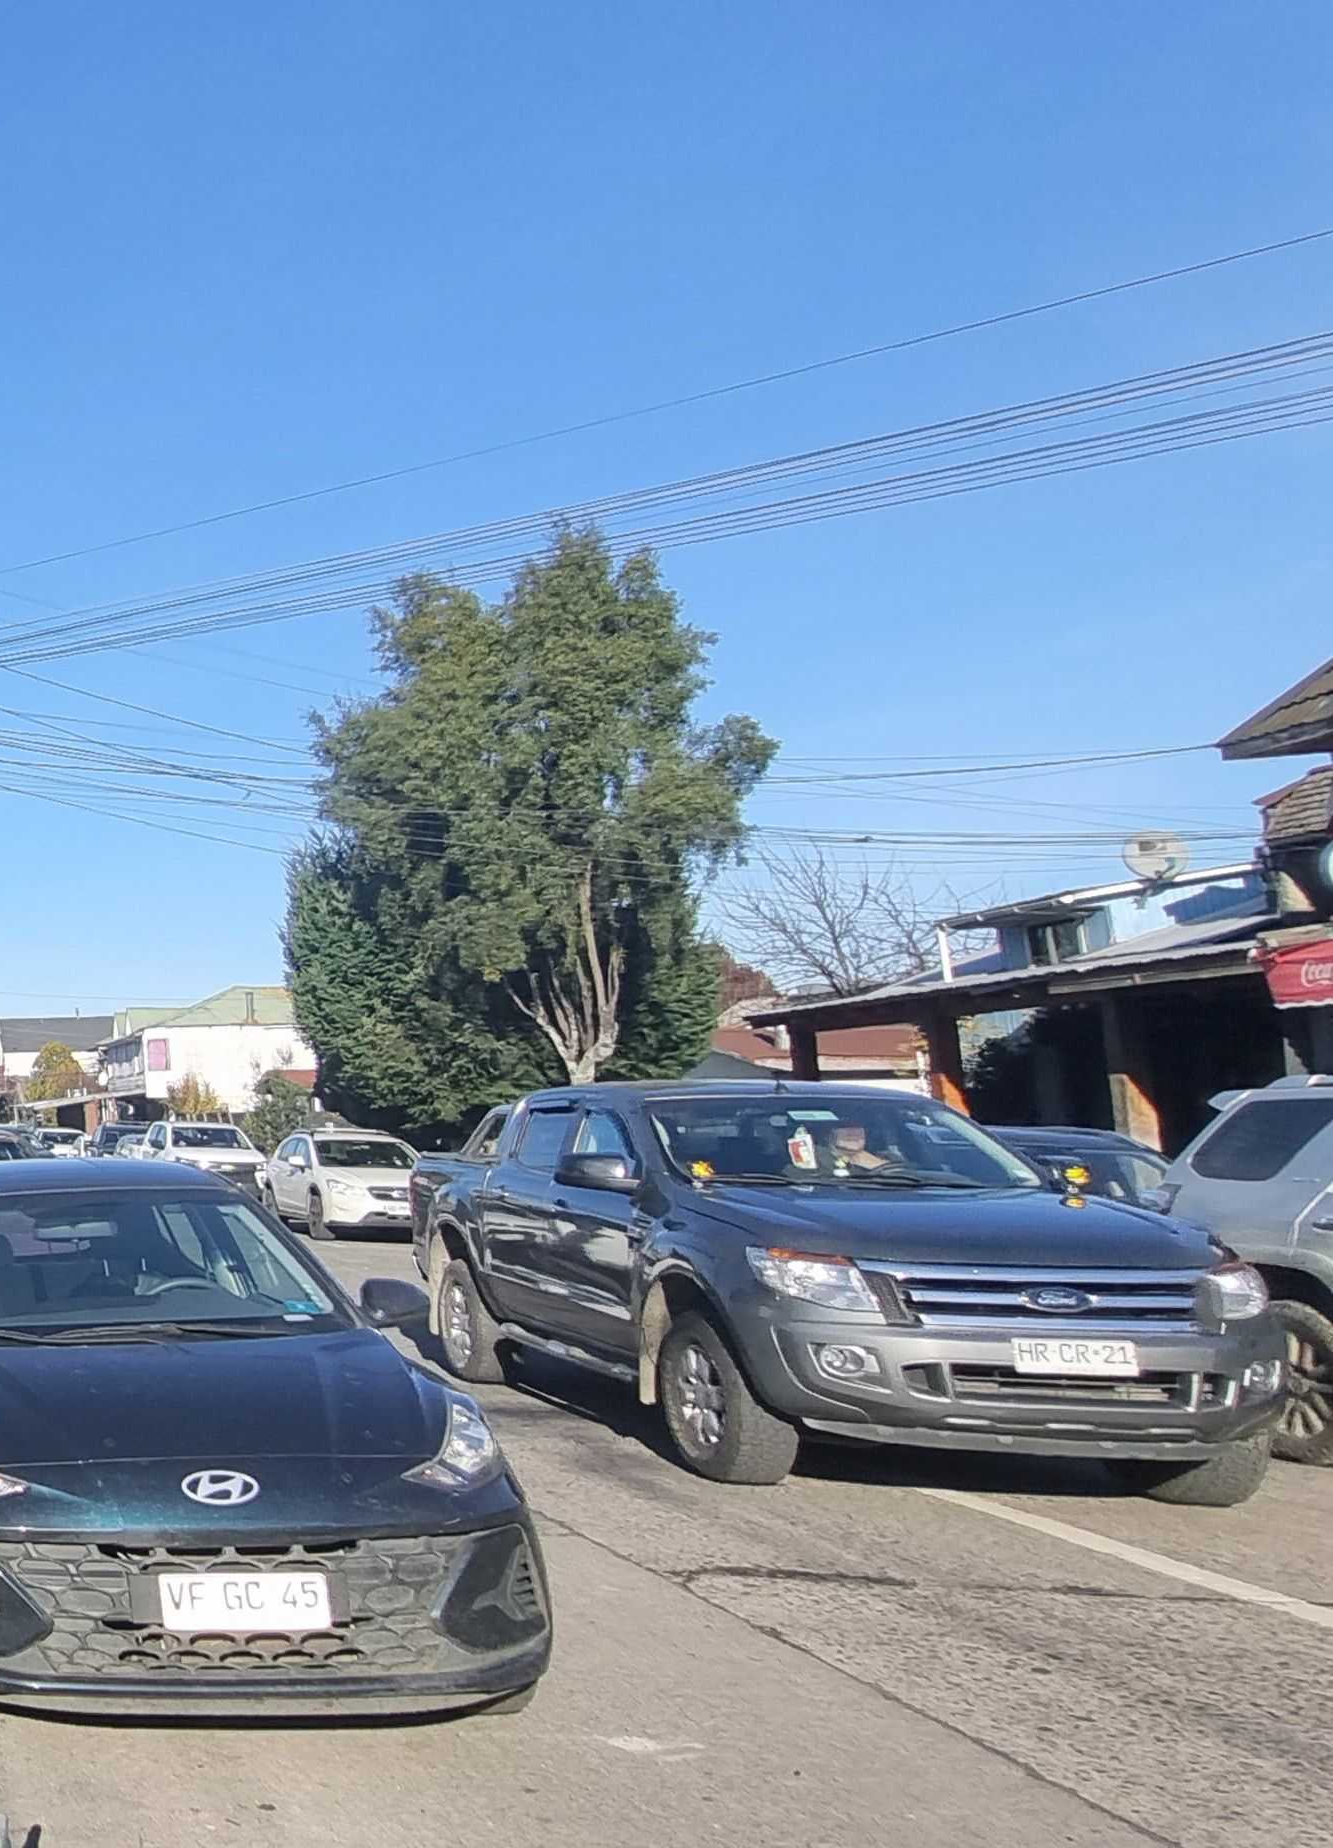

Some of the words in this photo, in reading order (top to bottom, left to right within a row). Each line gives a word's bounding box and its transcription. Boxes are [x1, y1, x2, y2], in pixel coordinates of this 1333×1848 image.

[167, 1581, 205, 1610] VF
[223, 1581, 265, 1610] GC
[282, 1581, 319, 1609] 45
